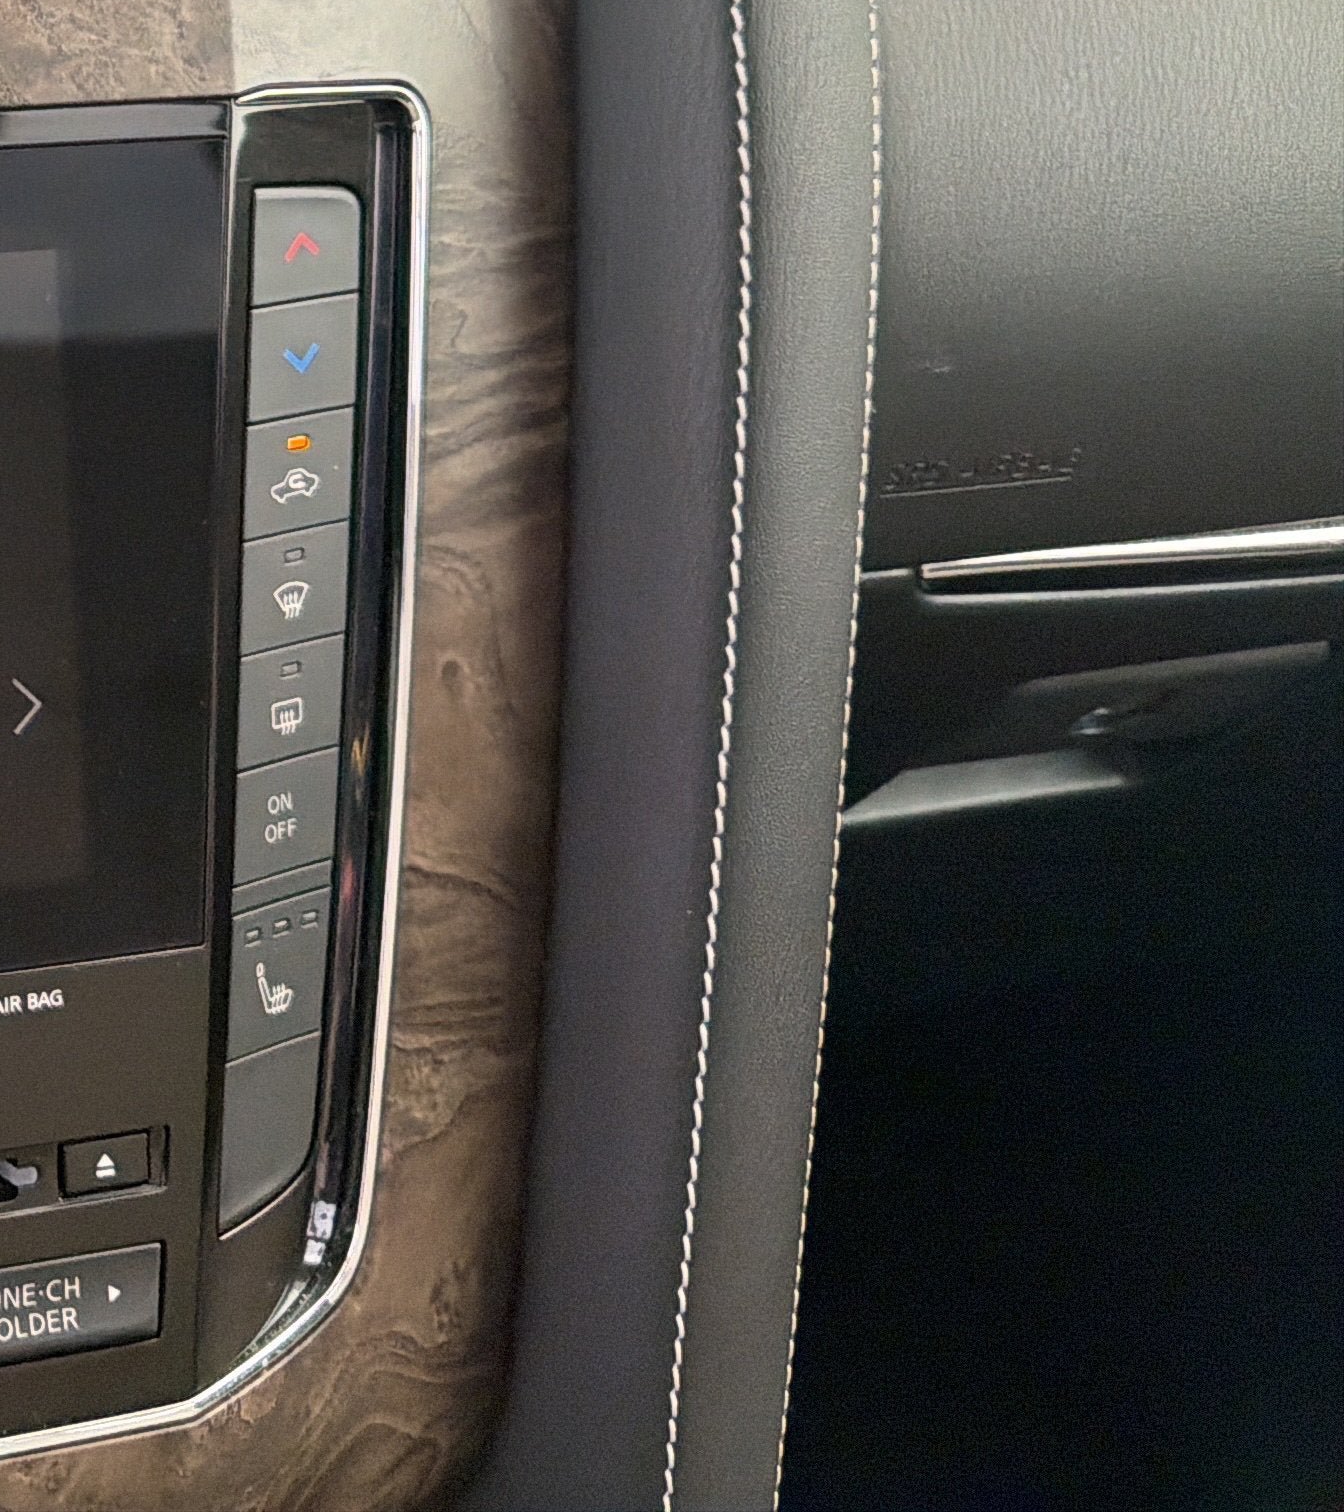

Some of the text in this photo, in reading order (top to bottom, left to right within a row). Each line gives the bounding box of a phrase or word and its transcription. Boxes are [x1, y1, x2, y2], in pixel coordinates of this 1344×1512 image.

[266, 792, 293, 815] ON
[264, 818, 298, 844] OFF
[27, 989, 64, 1010] BAG
